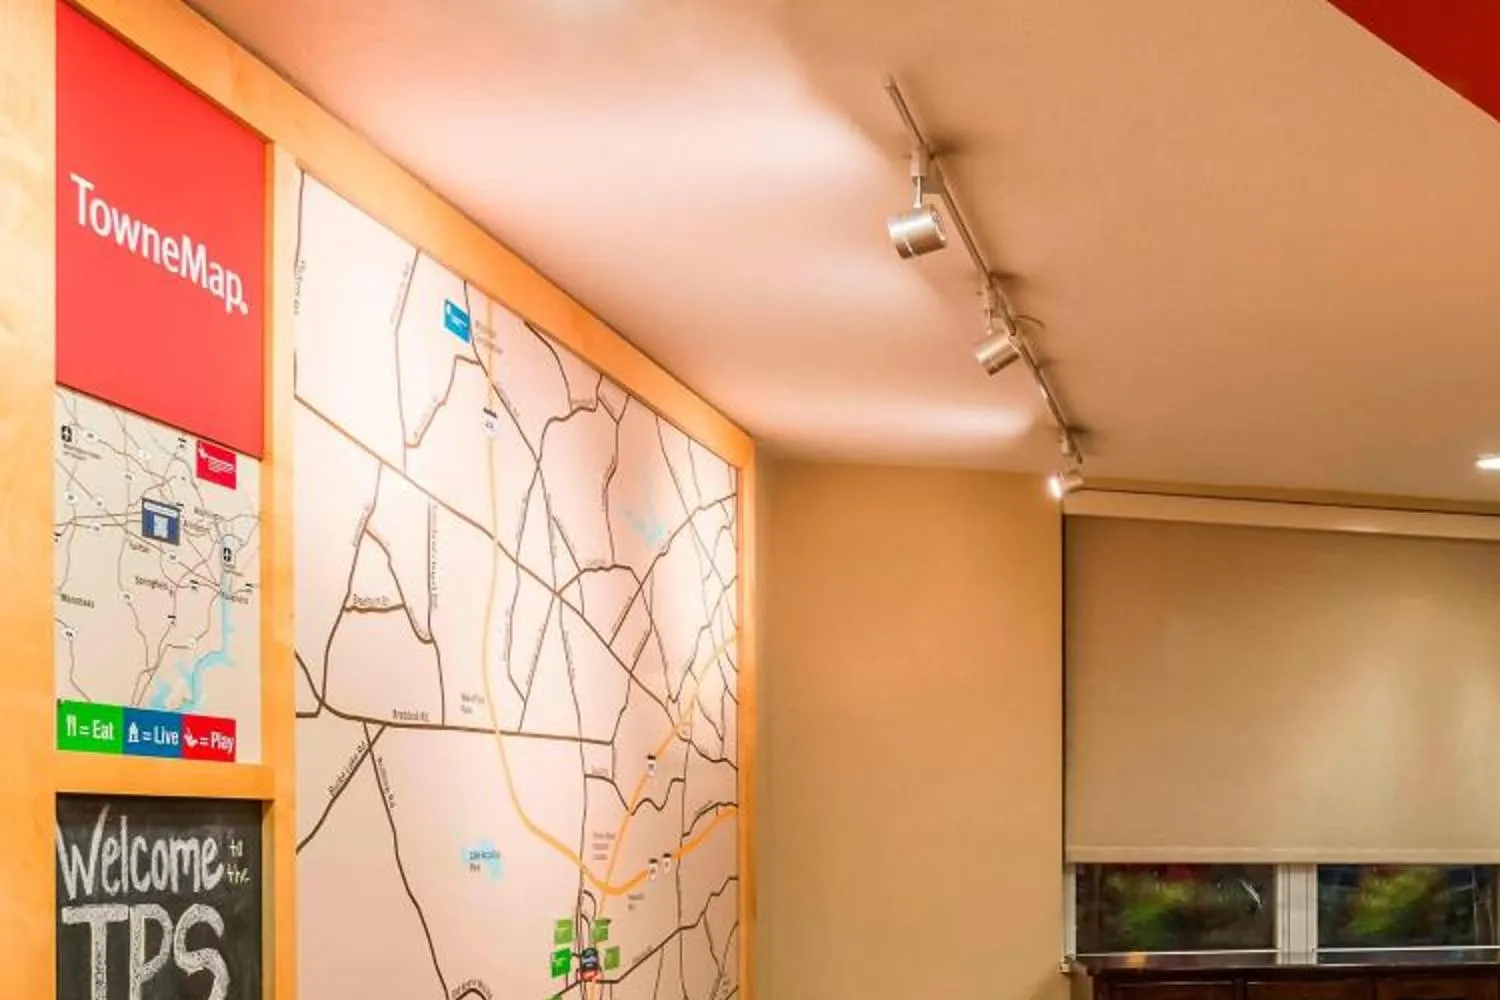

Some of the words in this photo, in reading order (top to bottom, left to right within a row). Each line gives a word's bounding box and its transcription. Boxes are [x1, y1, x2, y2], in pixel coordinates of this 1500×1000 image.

[92, 720, 114, 741] Eat
[153, 726, 180, 745] Live
[210, 732, 234, 753] Play
[56, 803, 224, 899] Welcome
